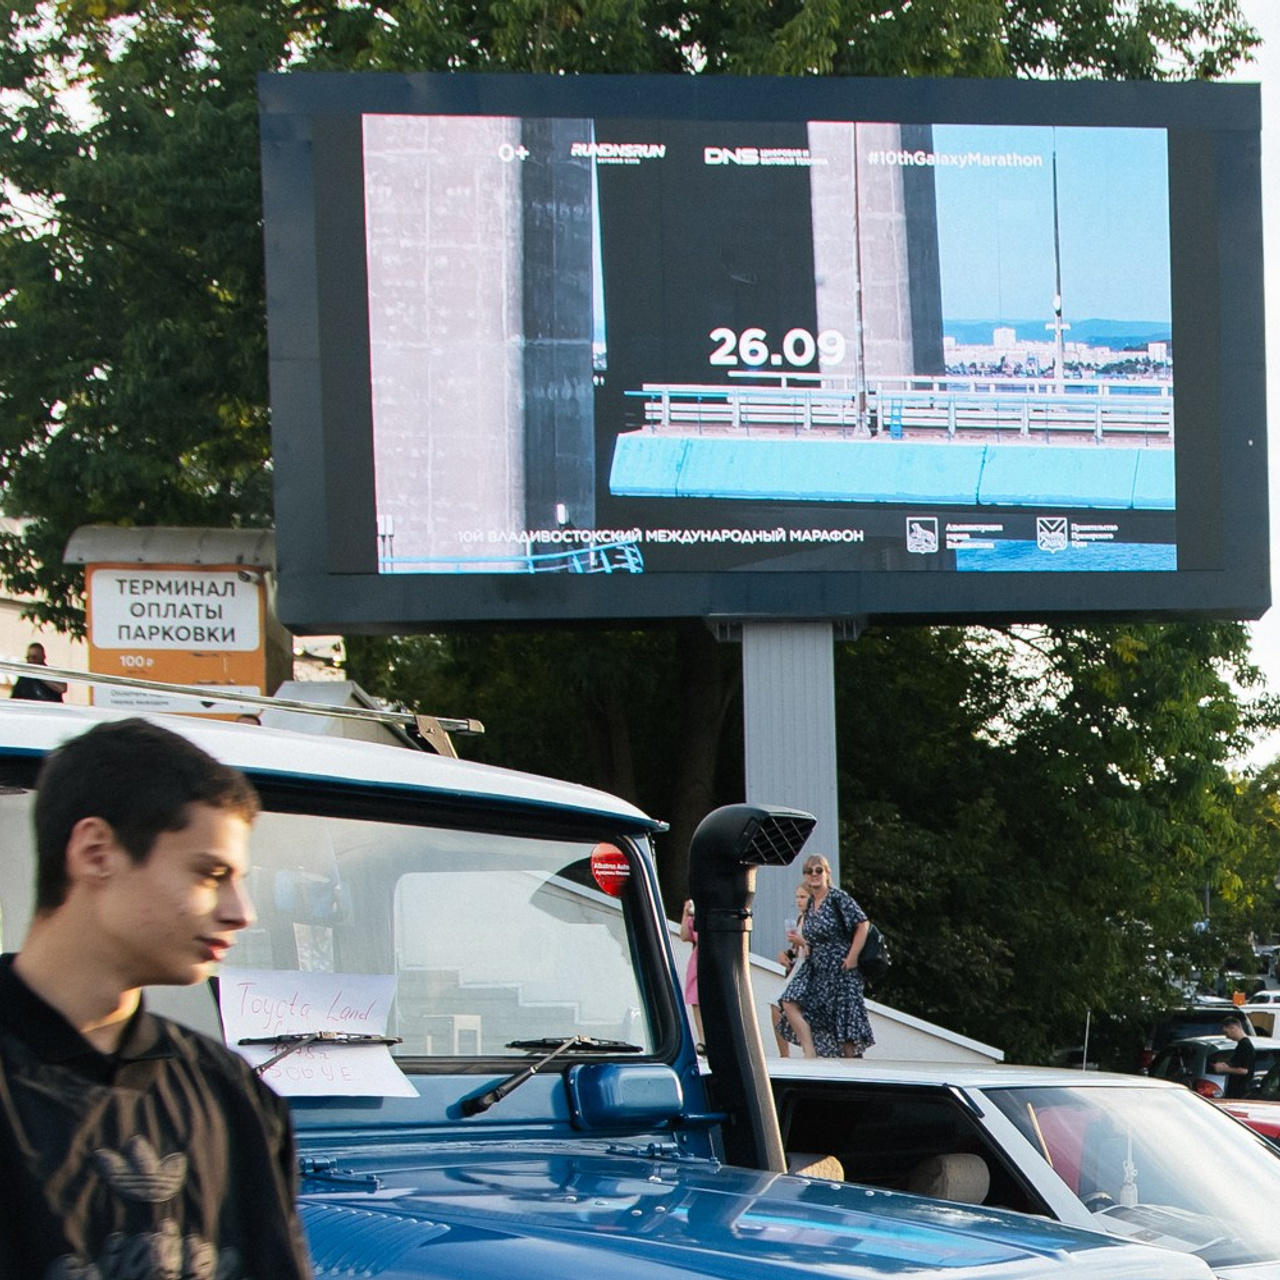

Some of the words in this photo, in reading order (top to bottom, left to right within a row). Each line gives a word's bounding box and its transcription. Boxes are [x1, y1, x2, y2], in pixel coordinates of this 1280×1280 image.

[498, 143, 529, 163] 0+
[704, 146, 759, 166] DNS
[867, 149, 1043, 168] #10thGalaxyMarathon
[708, 327, 846, 367] 26.09
[487, 528, 643, 544] ВЛАДИВОСТОКСКИЙ
[645, 528, 787, 544] МЕЖДУНАРОДНЫЙ
[789, 529, 865, 543] МАРАФОН
[116, 578, 236, 598] ТЕРМИНАЛ
[129, 602, 223, 620] ОПЛАТЫ
[117, 624, 236, 643] ПАРКОВКИ
[236, 982, 312, 1029] Toyota
[326, 989, 377, 1022] Land
